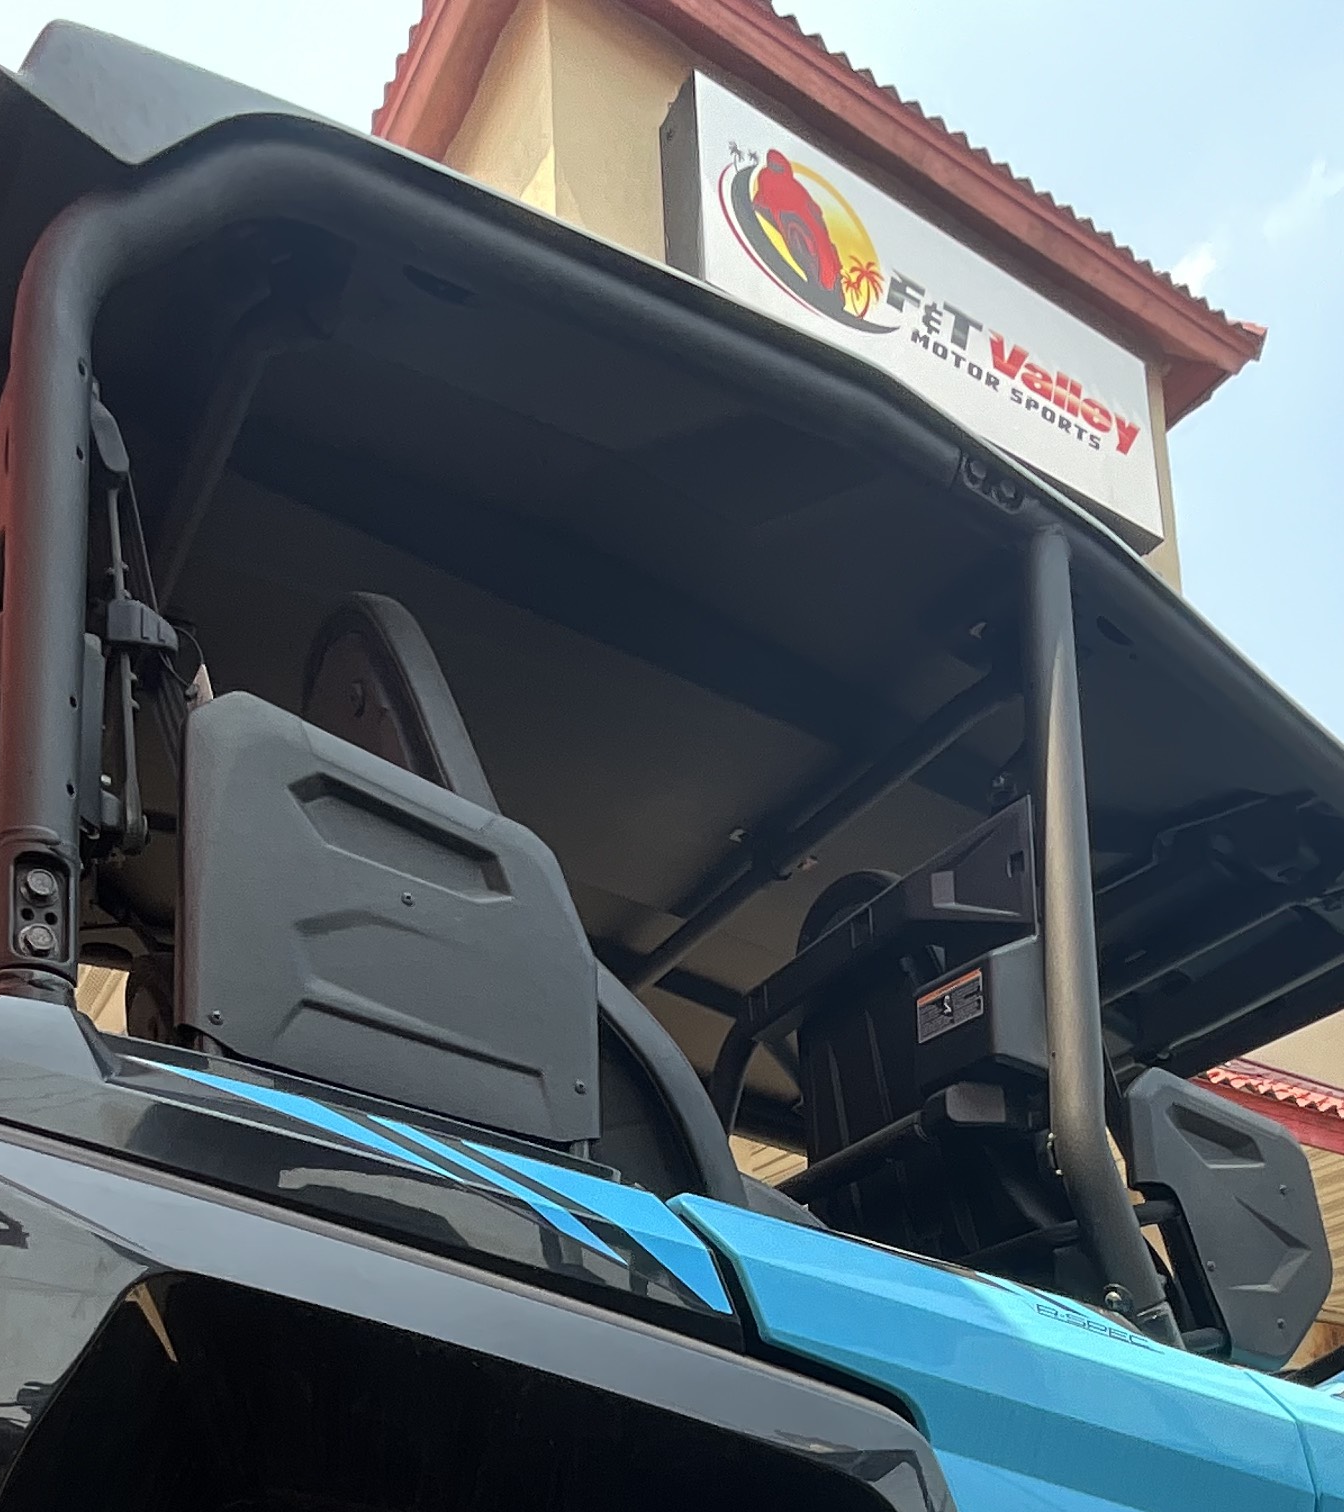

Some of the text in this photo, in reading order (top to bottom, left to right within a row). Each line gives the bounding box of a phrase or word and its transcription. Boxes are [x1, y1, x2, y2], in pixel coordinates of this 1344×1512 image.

[886, 268, 1140, 456] F&T Valley
[911, 329, 1102, 451] MOTOR SPORTS
